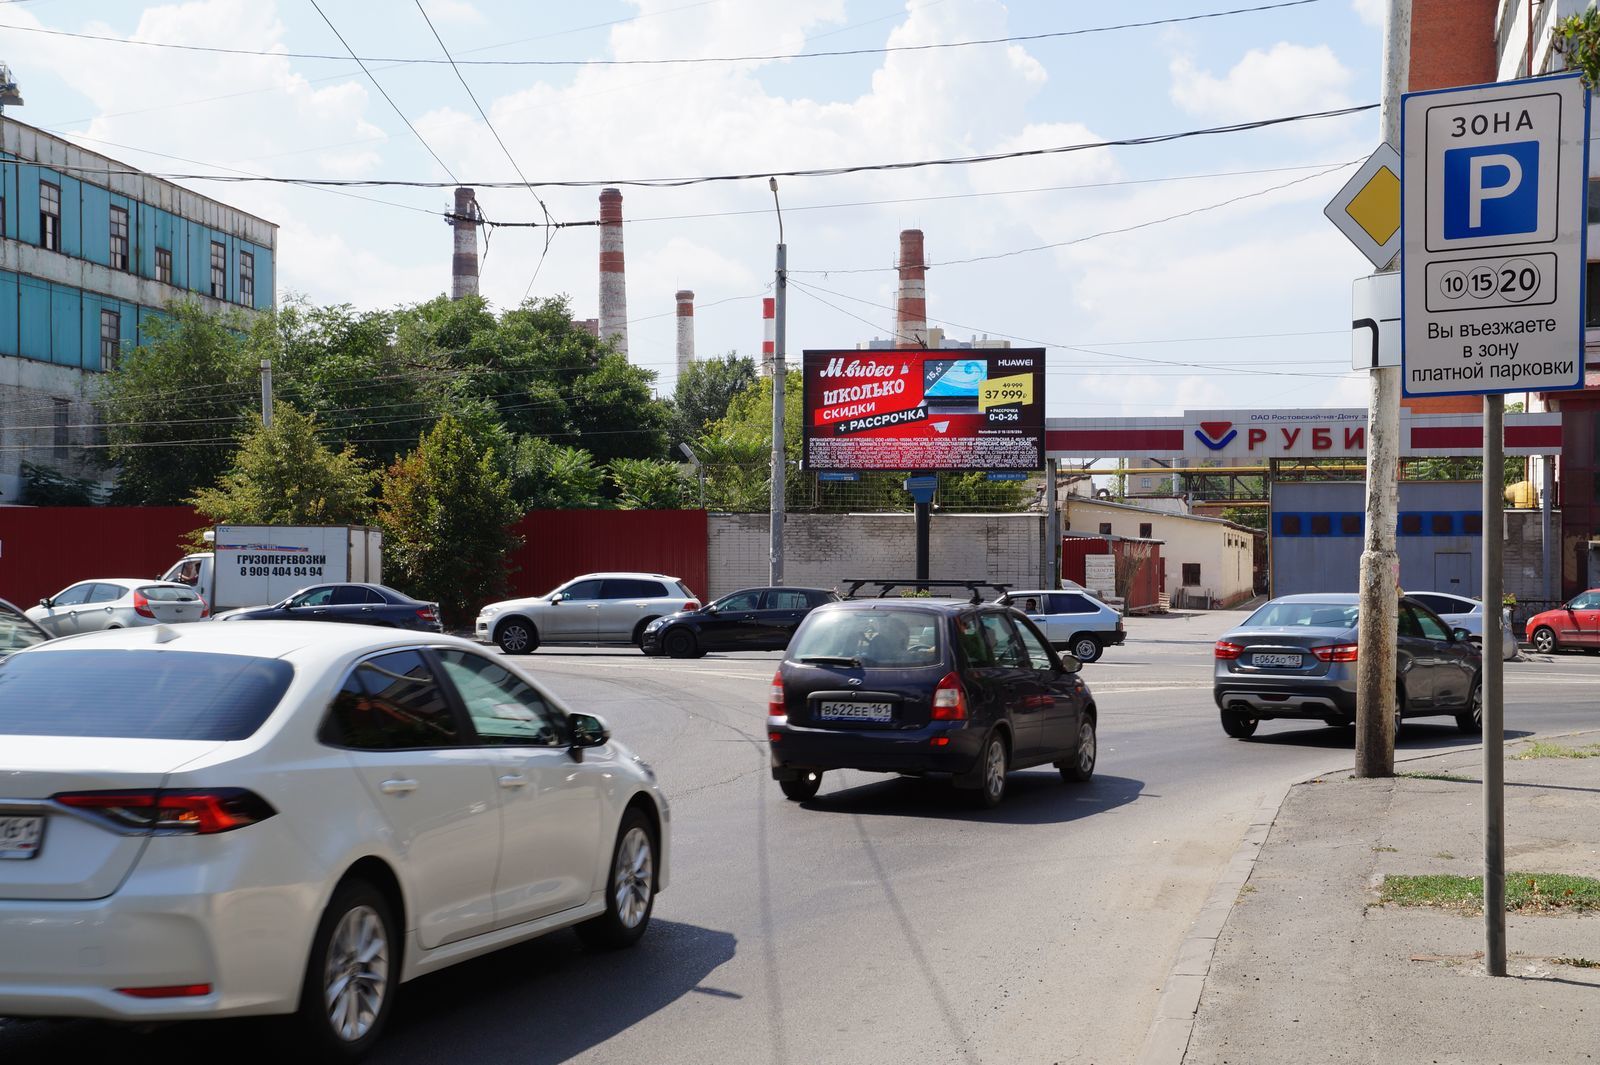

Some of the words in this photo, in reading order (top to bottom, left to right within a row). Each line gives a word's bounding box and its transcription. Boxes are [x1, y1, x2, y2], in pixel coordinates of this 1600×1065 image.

[1451, 110, 1534, 138] ЗОНА
[1468, 153, 1523, 229] P
[1444, 276, 1464, 293] 10
[1470, 273, 1493, 291] 15
[1499, 270, 1536, 293] 20
[1427, 322, 1454, 340] Вы
[1459, 317, 1556, 338] въезжаете
[1462, 344, 1473, 358] в
[1478, 342, 1519, 361] зону
[997, 359, 1034, 367] HUAWEI
[1411, 362, 1484, 382] платной
[1489, 359, 1574, 379] парковки
[823, 378, 905, 406] ШКОЛЬКО
[984, 390, 999, 400] 37
[823, 401, 876, 420] СКИДКИ
[849, 408, 926, 431] РАССРОЧКА
[989, 413, 1019, 421] 0-0-24
[1271, 413, 1359, 421] Ростовский-на-Дону
[1248, 427, 1365, 451] РУБИ
[236, 554, 327, 565] ГРУЗОПЕРЕВОЗКИ
[240, 566, 247, 576] 8
[249, 566, 270, 577] 909
[271, 566, 292, 577] 404
[294, 566, 308, 577] 94
[309, 566, 323, 577] 94
[824, 704, 868, 716] В622ЕЕ
[872, 704, 889, 714] 161
